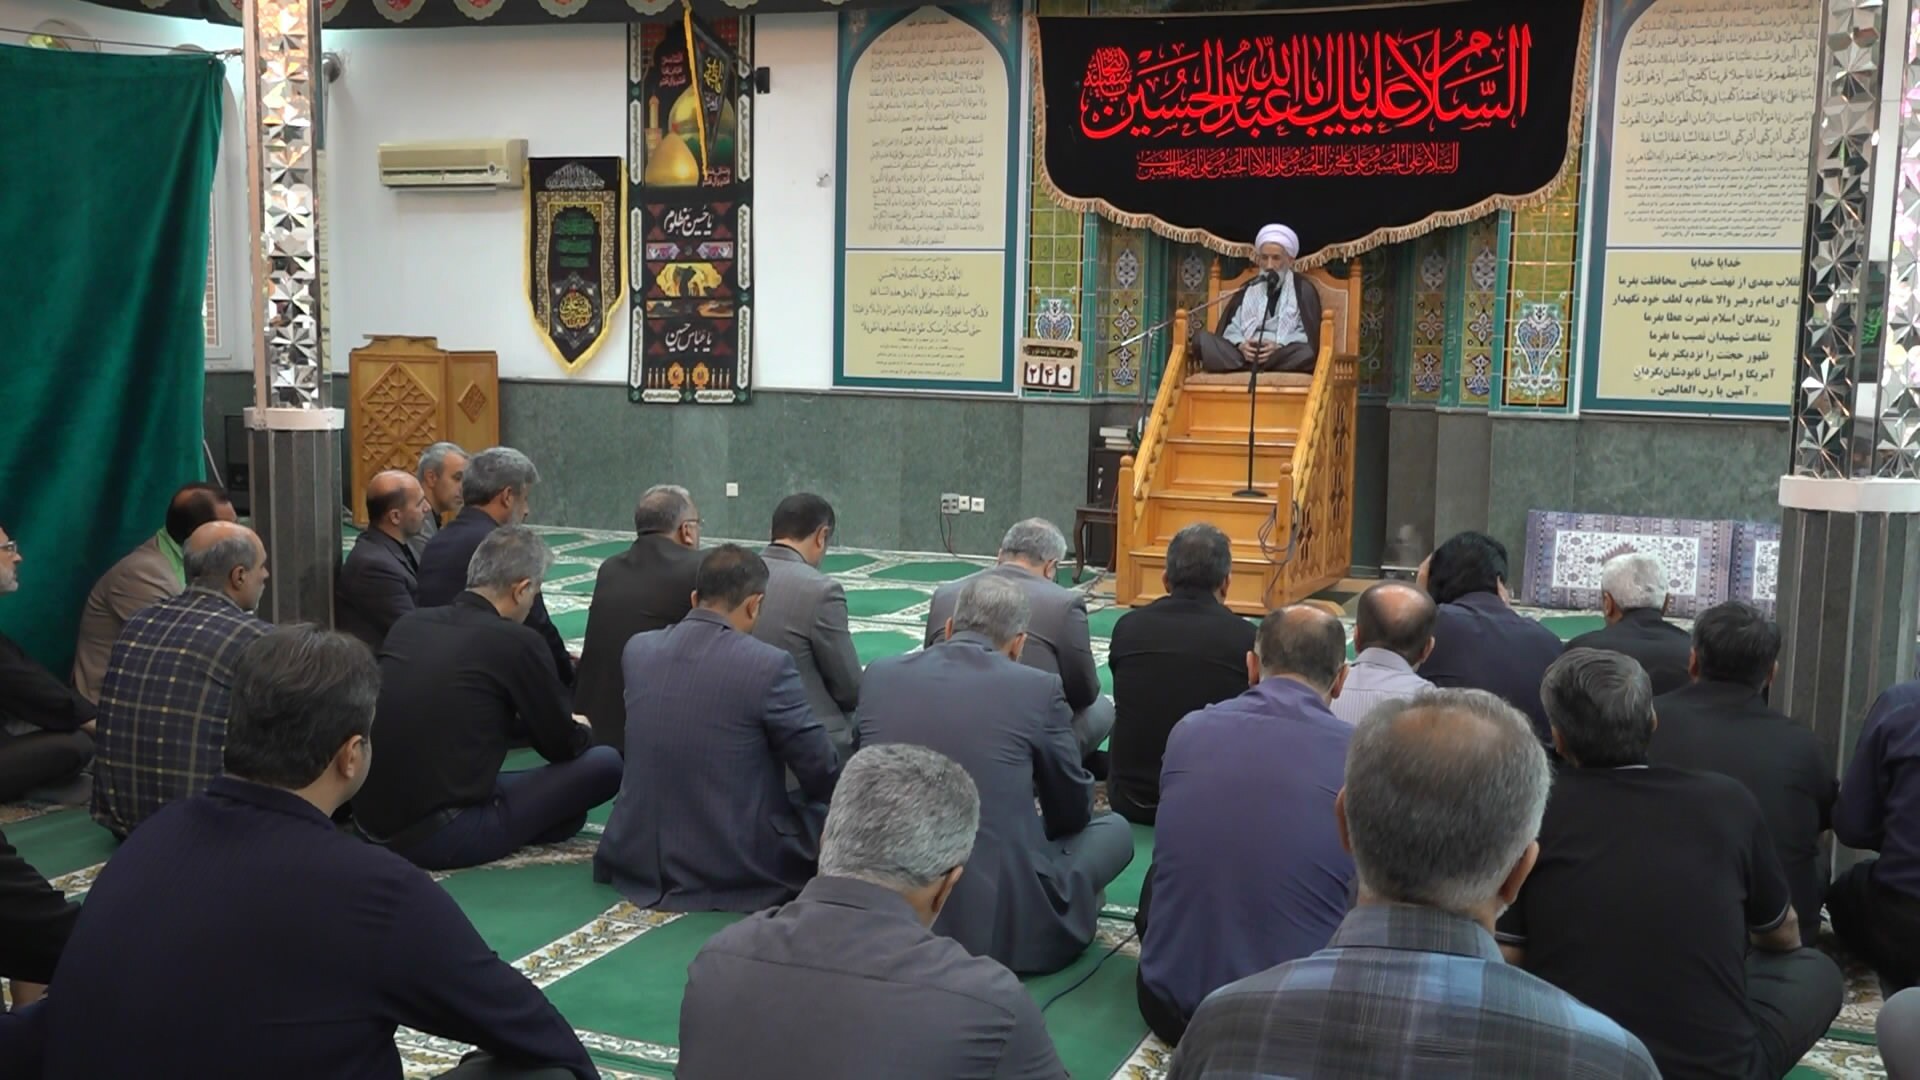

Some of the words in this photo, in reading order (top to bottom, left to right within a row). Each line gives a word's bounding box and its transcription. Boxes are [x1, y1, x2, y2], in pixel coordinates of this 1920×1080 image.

[663, 207, 691, 237] مظلوم
[682, 204, 710, 238] حسین
[1690, 256, 1715, 270] خدایا
[1716, 256, 1742, 270] خدایا
[664, 322, 692, 353] حسین
[677, 329, 707, 354] عباس
[1647, 348, 1670, 362] بفرما
[1671, 348, 1702, 362] نزدیکتر
[1704, 348, 1714, 362] را
[1746, 351, 1770, 365] ظهور
